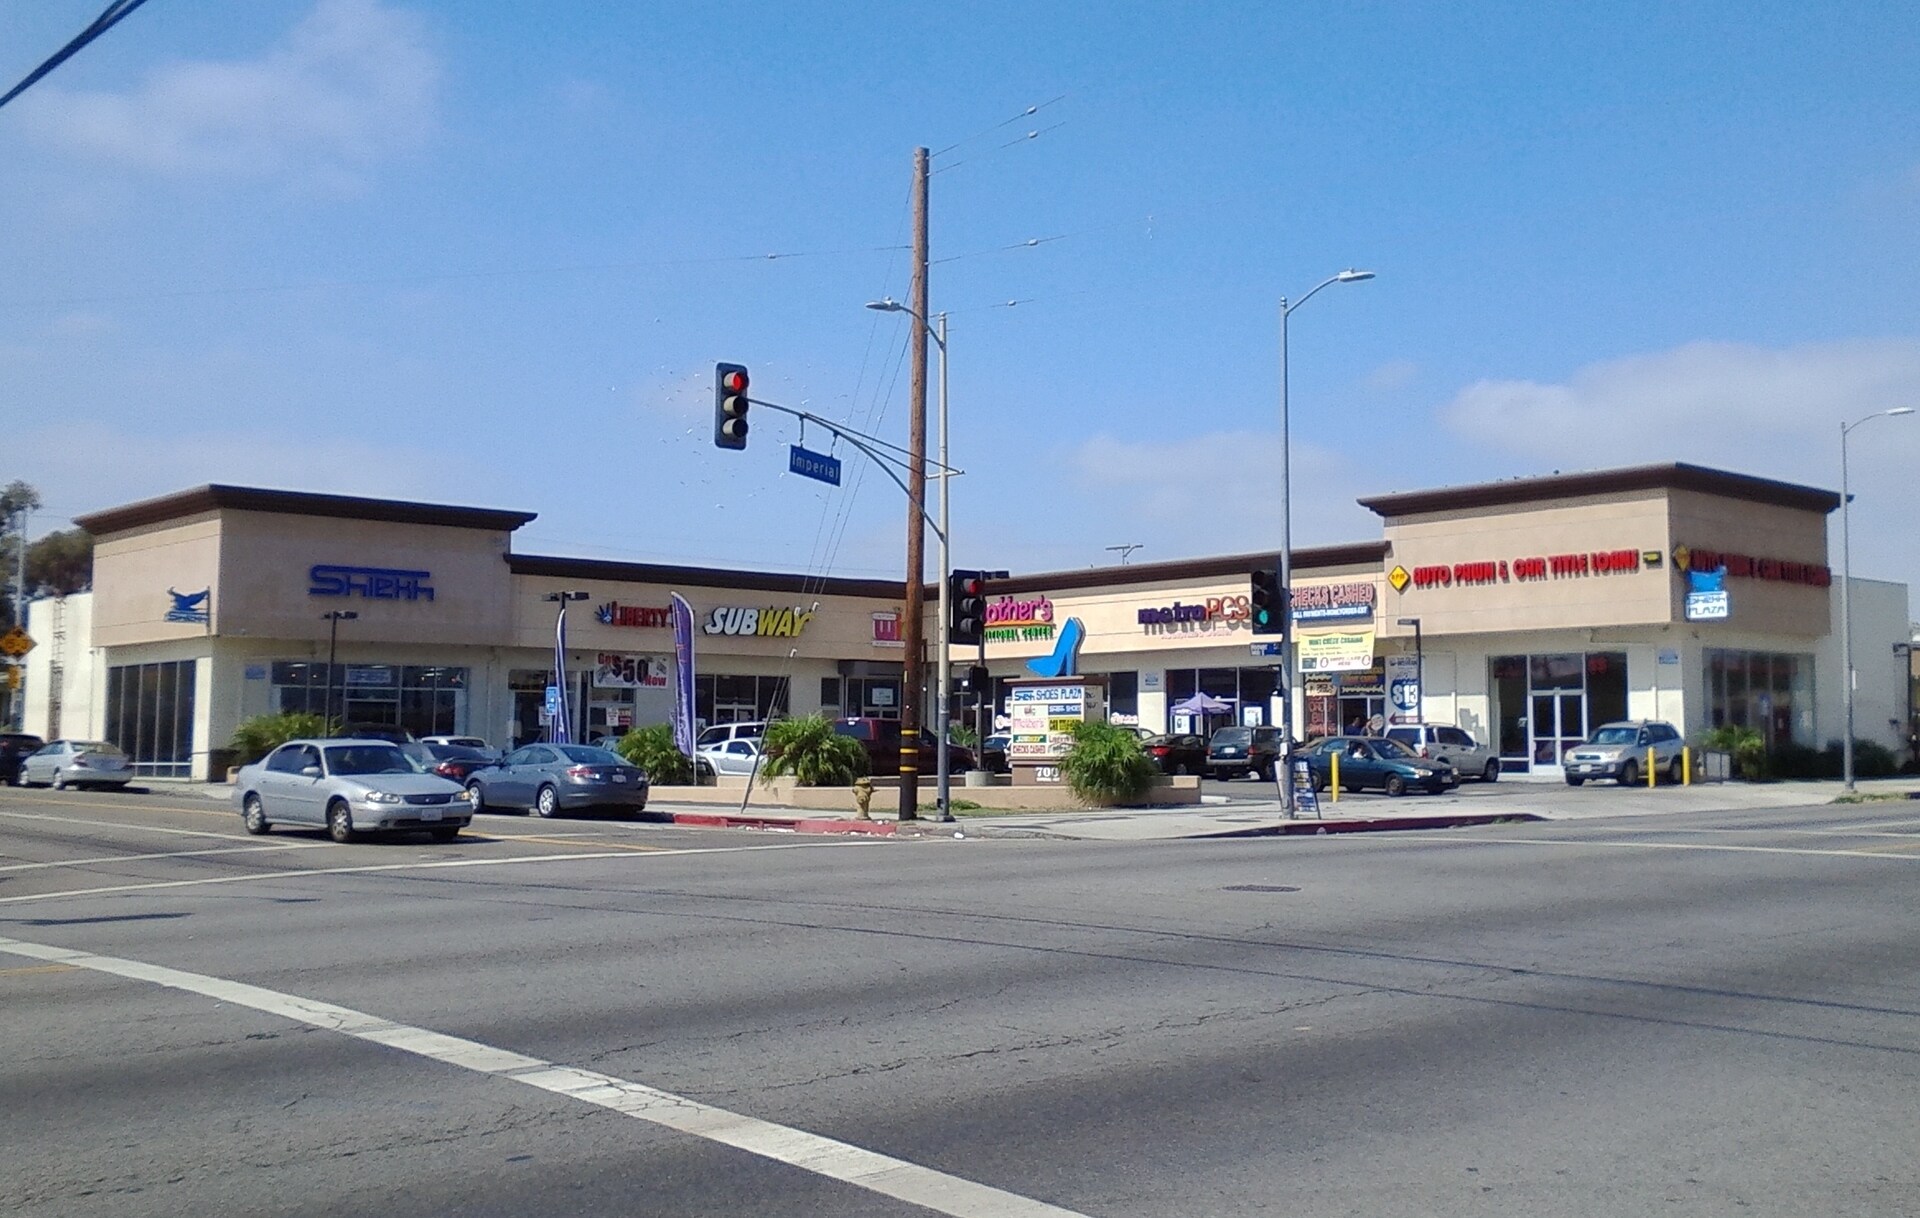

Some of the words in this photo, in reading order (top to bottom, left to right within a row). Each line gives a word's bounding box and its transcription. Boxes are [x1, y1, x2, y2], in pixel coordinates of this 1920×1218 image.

[792, 452, 839, 480] Imperial
[1414, 566, 1451, 585] AUTO
[1513, 557, 1547, 577] CAR
[1548, 553, 1588, 575] TITLE
[1330, 582, 1374, 606] CASHED
[612, 601, 668, 628] LIBERTY
[705, 607, 814, 637] SUBWAY
[985, 595, 1054, 624] other's
[1138, 595, 1250, 624] metroPCS
[1688, 606, 1726, 616] PLAZA
[1023, 625, 1054, 640] CENTER
[611, 656, 648, 683] $50
[645, 675, 667, 686] Now
[1036, 689, 1059, 700] SHOES
[1061, 688, 1082, 699] PLAZA
